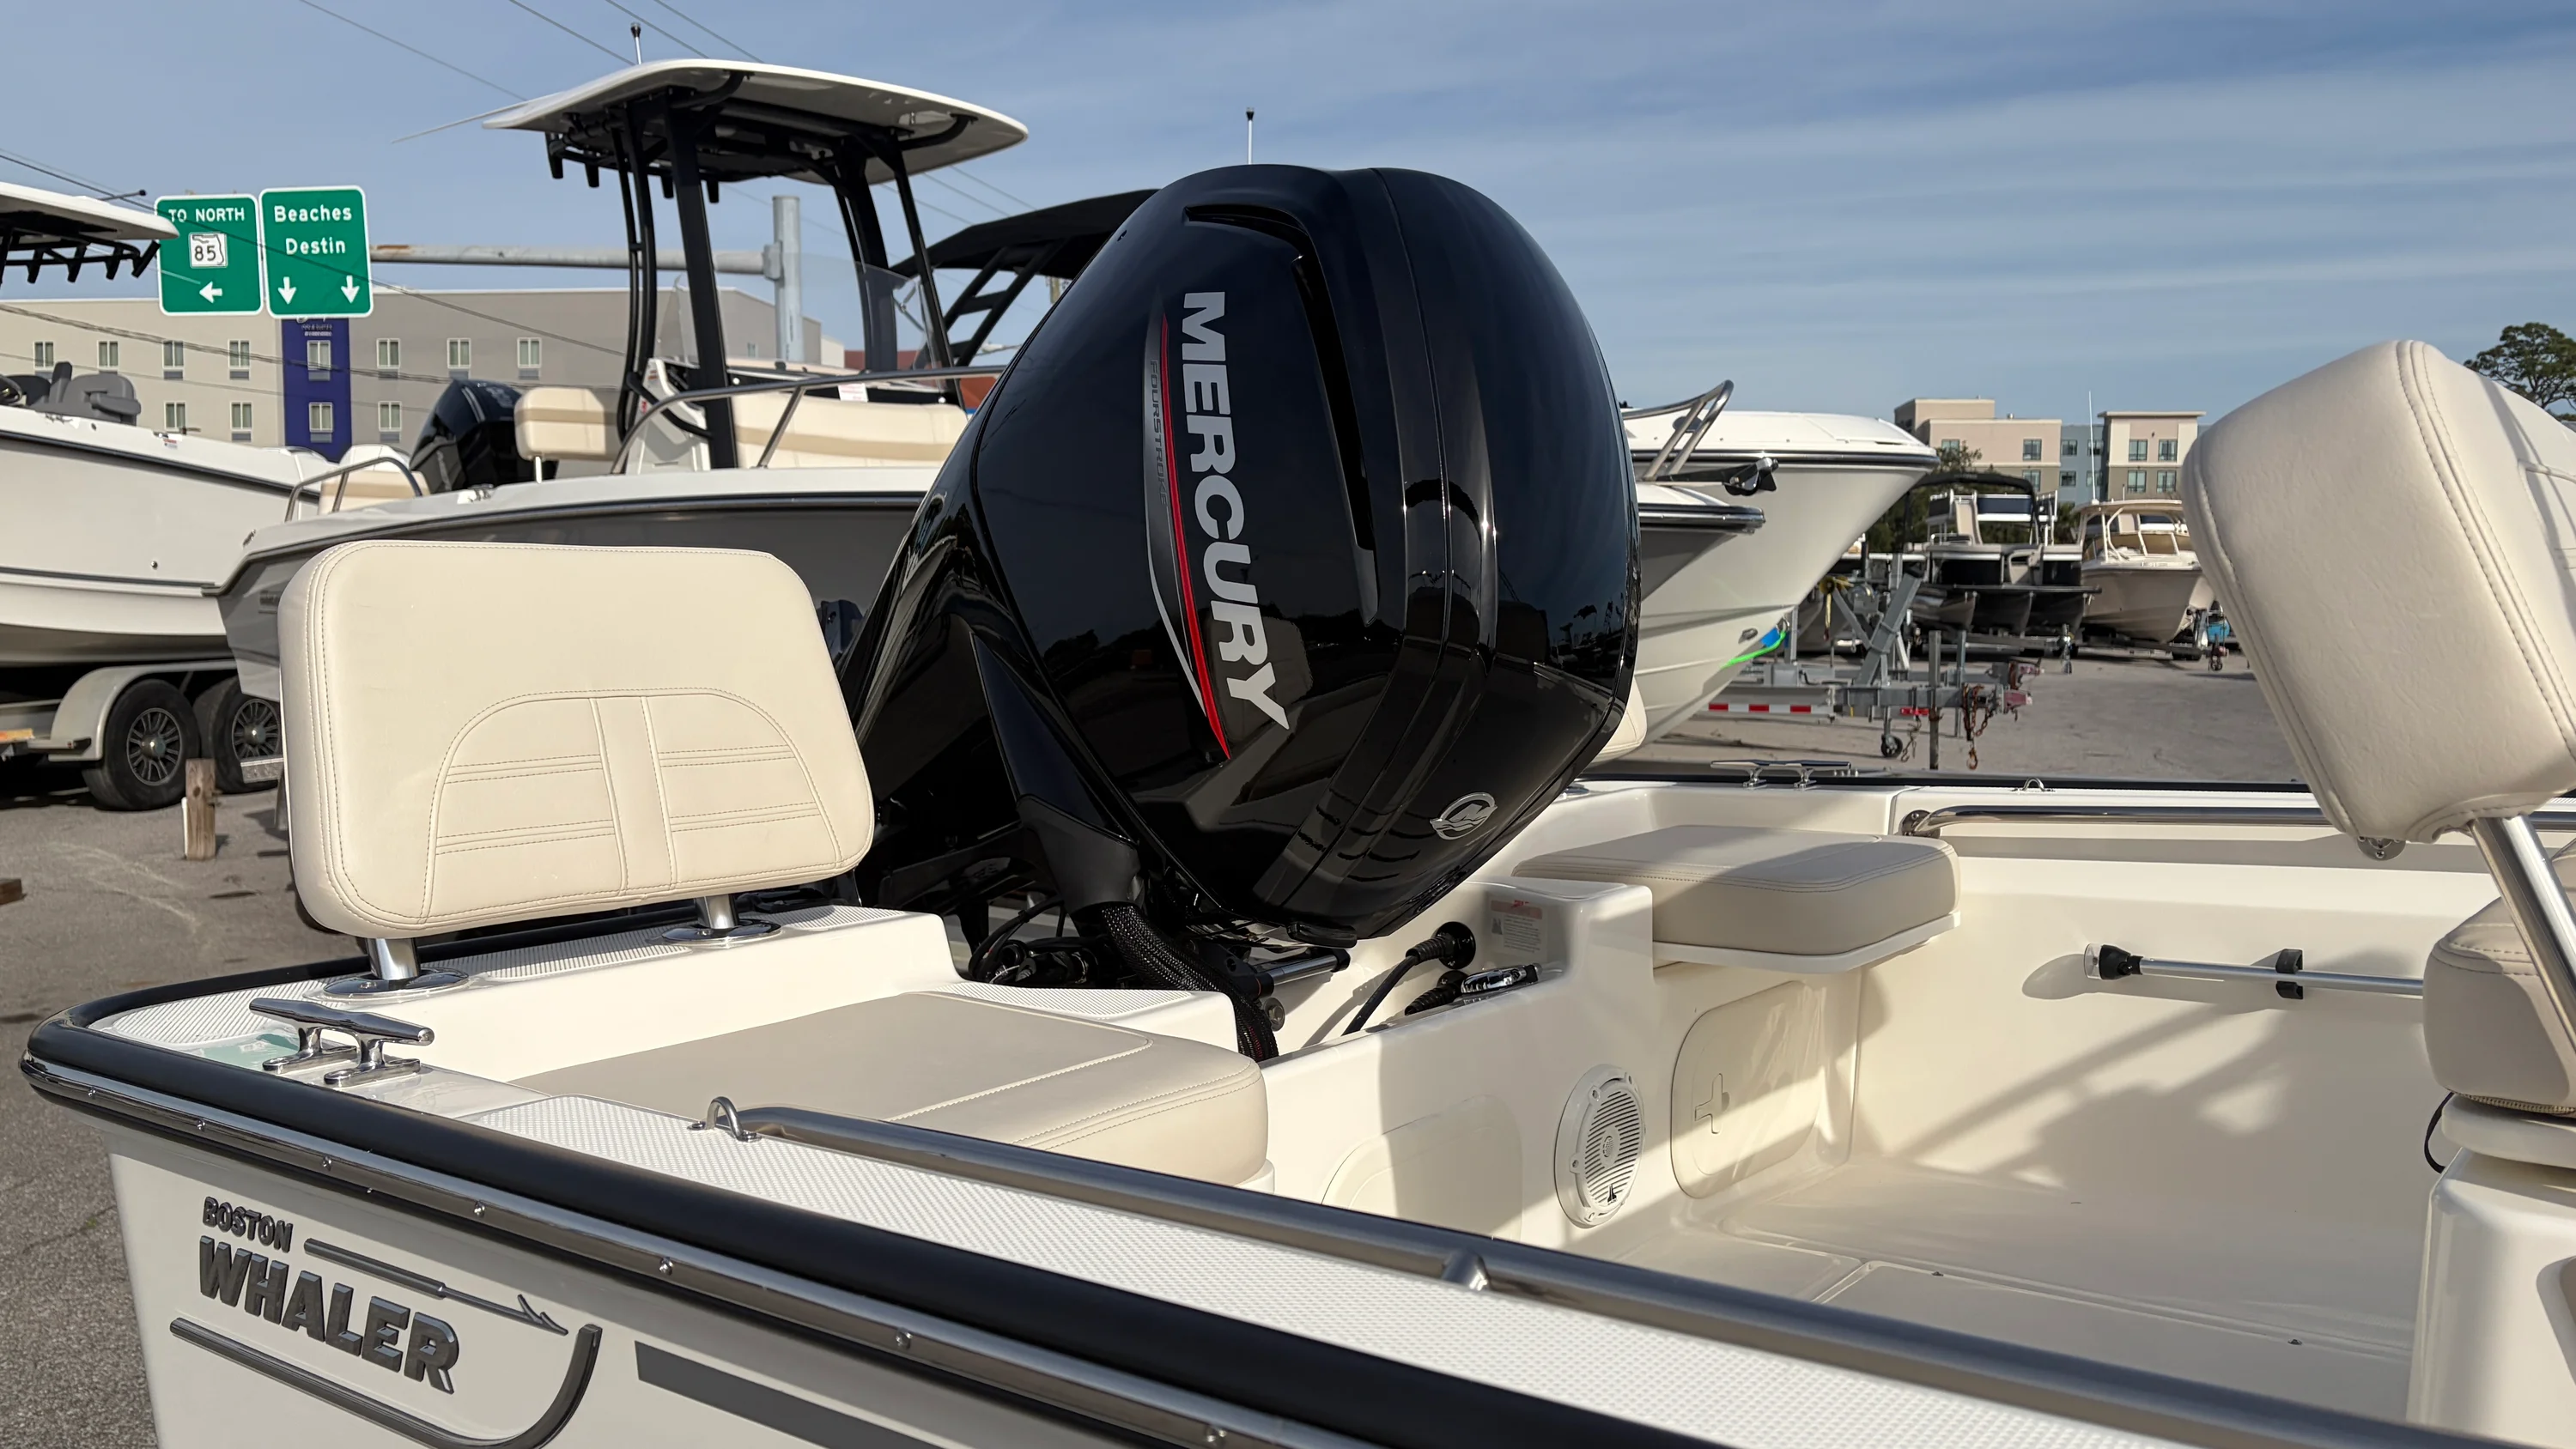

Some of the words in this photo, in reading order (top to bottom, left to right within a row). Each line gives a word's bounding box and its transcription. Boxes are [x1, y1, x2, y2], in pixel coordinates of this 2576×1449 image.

[168, 209, 187, 222] TO
[195, 207, 245, 221] NORTH
[274, 204, 352, 222] Beaches
[194, 246, 216, 261] 85
[286, 236, 345, 255] Destin
[1150, 359, 1168, 506] FOURSTROKE
[1182, 291, 1290, 730] MERCURY
[203, 1196, 294, 1253] BOSTON
[199, 1235, 459, 1395] WHALER
